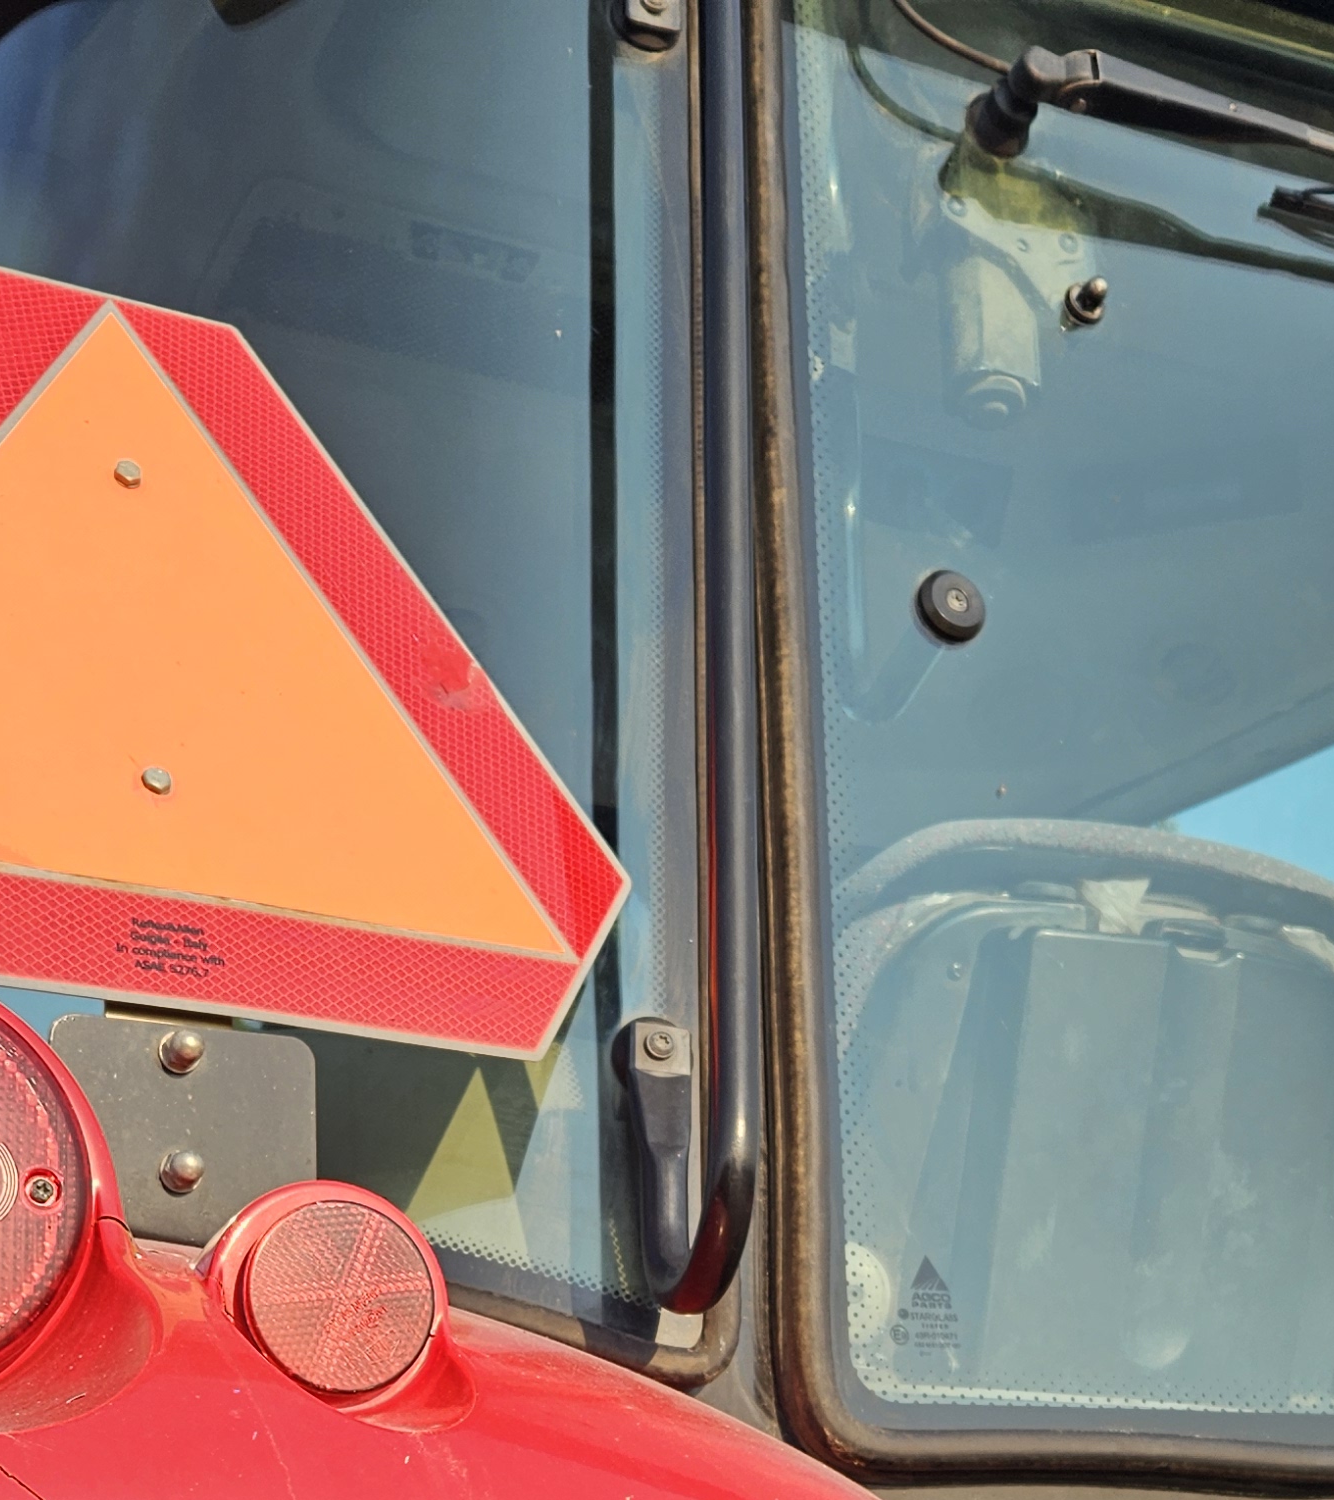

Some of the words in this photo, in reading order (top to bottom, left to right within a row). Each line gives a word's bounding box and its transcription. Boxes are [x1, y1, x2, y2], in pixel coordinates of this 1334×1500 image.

[116, 942, 129, 954] In
[132, 946, 198, 960] compliance
[200, 954, 226, 967] with
[183, 937, 208, 952] Italy
